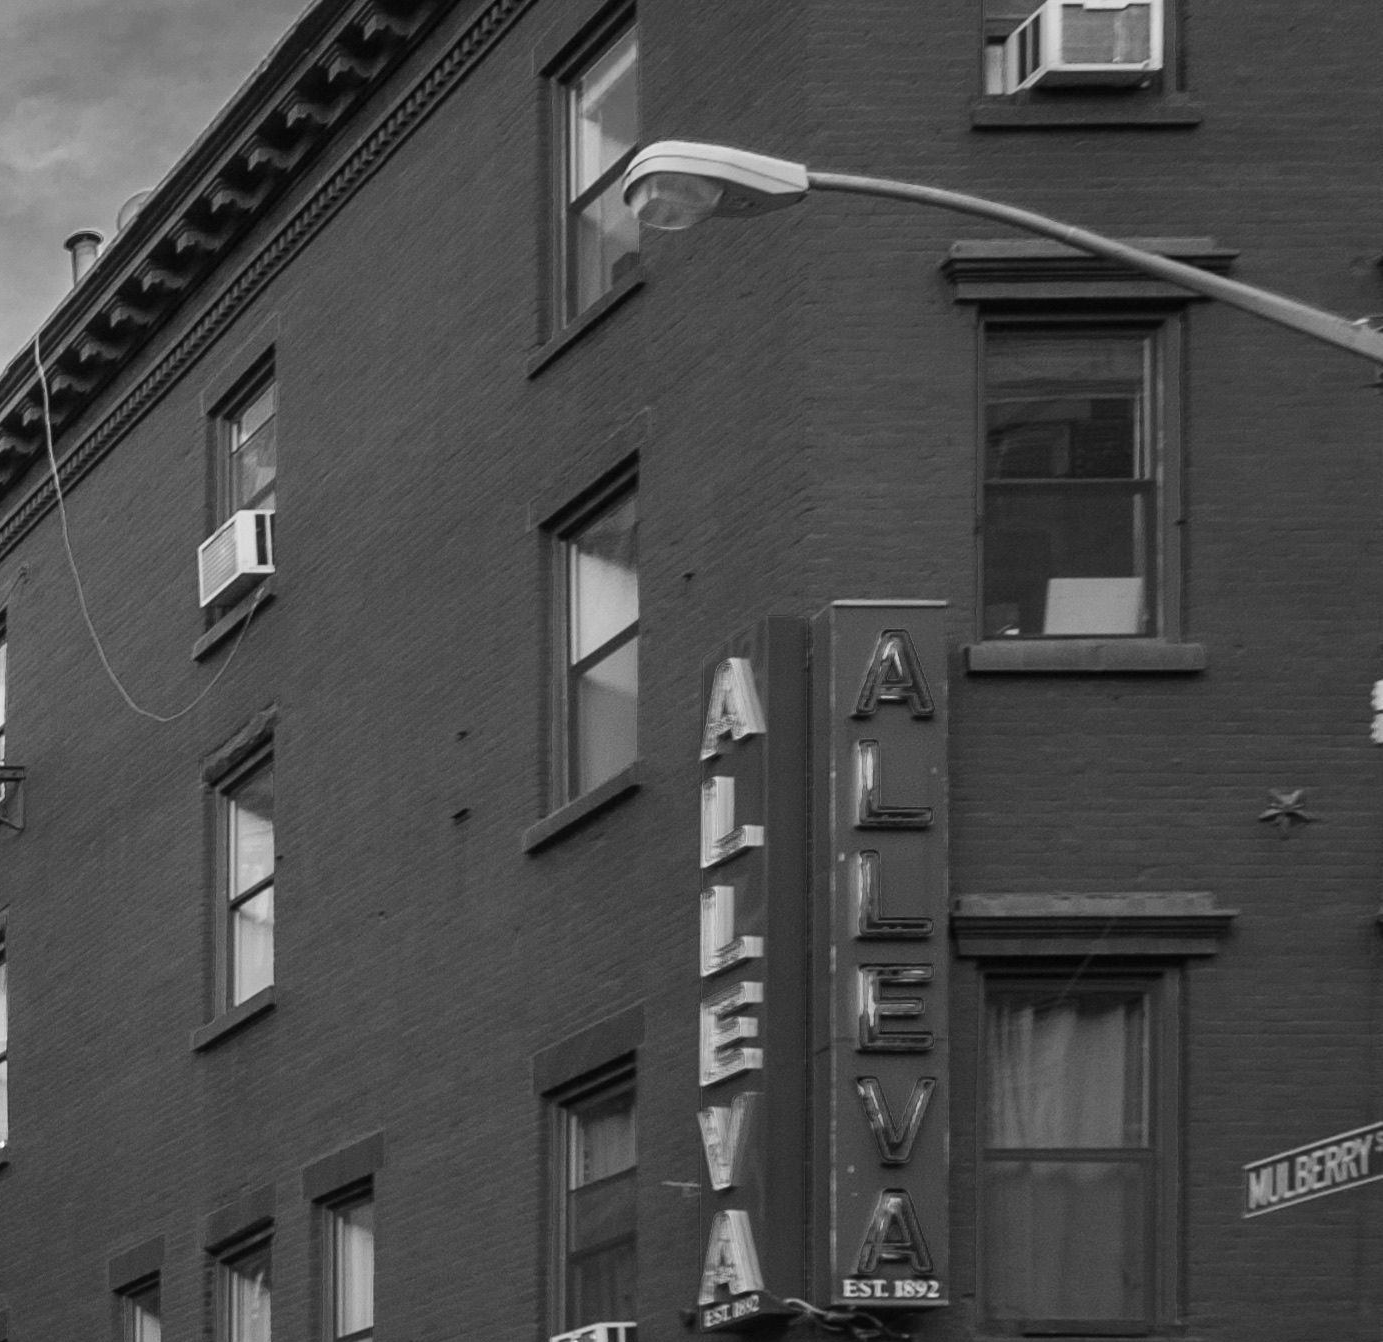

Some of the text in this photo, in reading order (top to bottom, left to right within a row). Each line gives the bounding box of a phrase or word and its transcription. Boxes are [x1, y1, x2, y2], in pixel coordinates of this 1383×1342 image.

[697, 657, 767, 1305] ALLEVA
[852, 629, 937, 1277] ALLEVA
[842, 1279, 941, 1298] EST. 1892
[1248, 1133, 1373, 1210] MULBERRY
